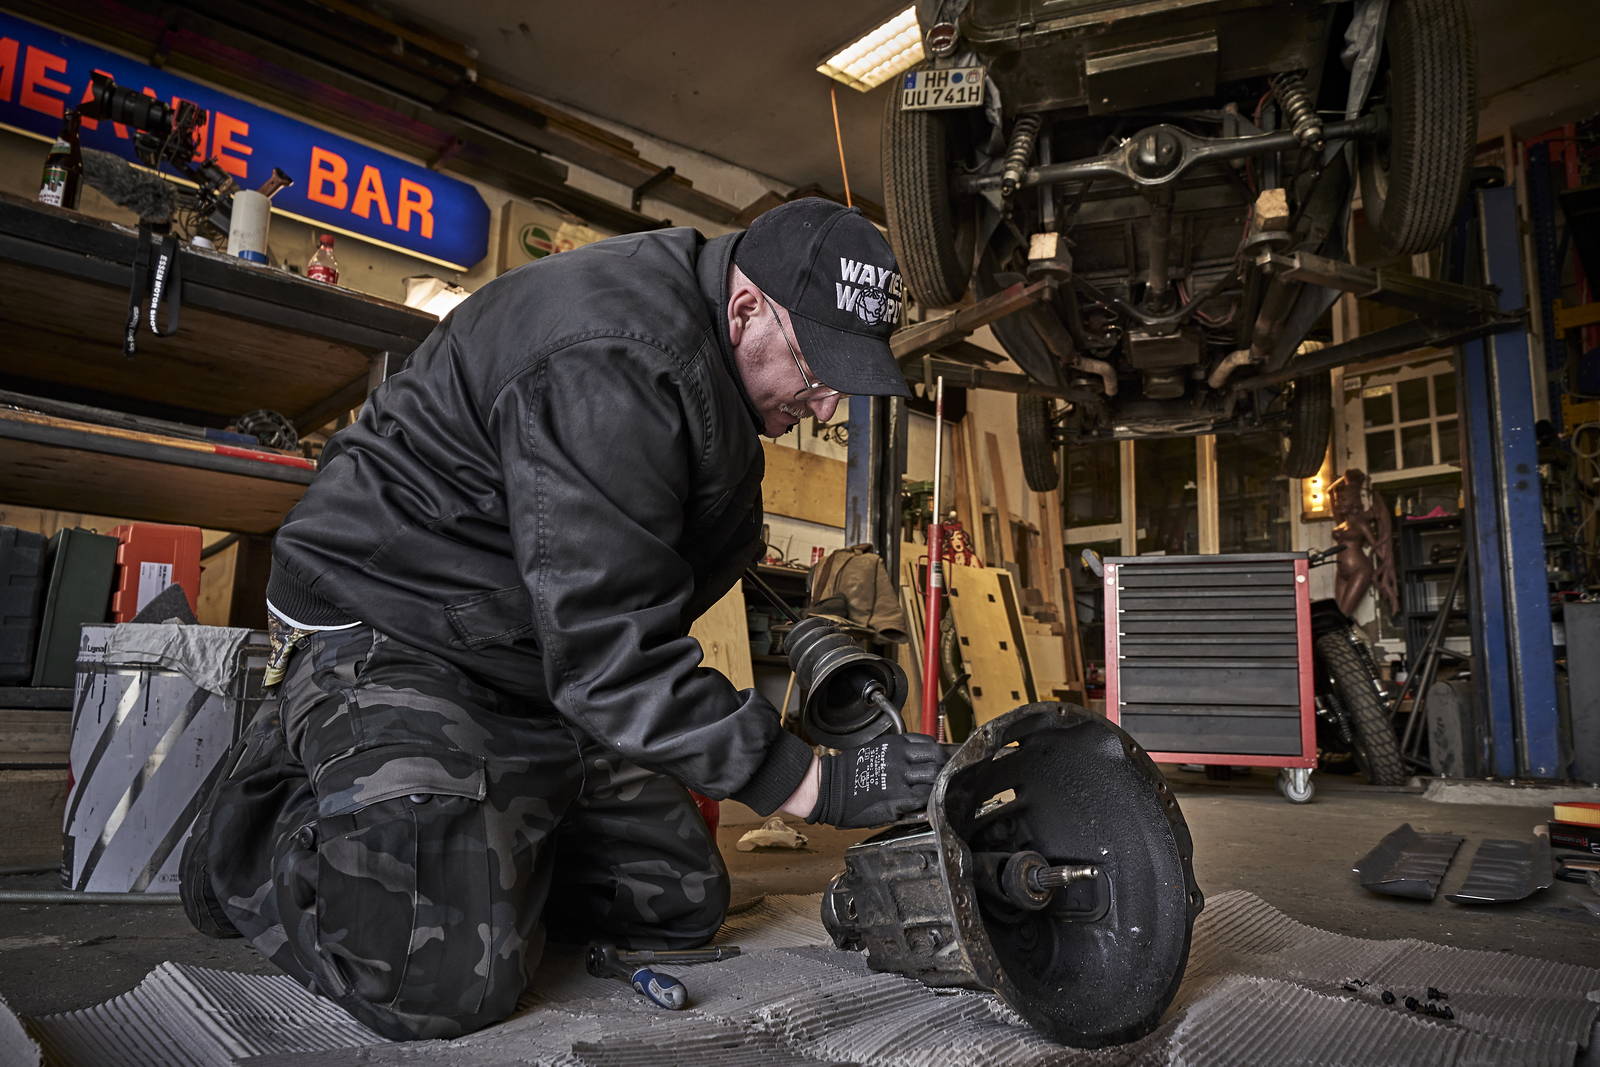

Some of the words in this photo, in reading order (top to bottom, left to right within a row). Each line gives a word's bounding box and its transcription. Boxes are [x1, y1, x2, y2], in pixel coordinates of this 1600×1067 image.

[925, 71, 949, 88] HH
[933, 86, 980, 104] 741H
[307, 146, 434, 239] BAR
[156, 254, 167, 280] ESSEN
[151, 281, 162, 308] MOTOR
[150, 310, 159, 334] SHOW
